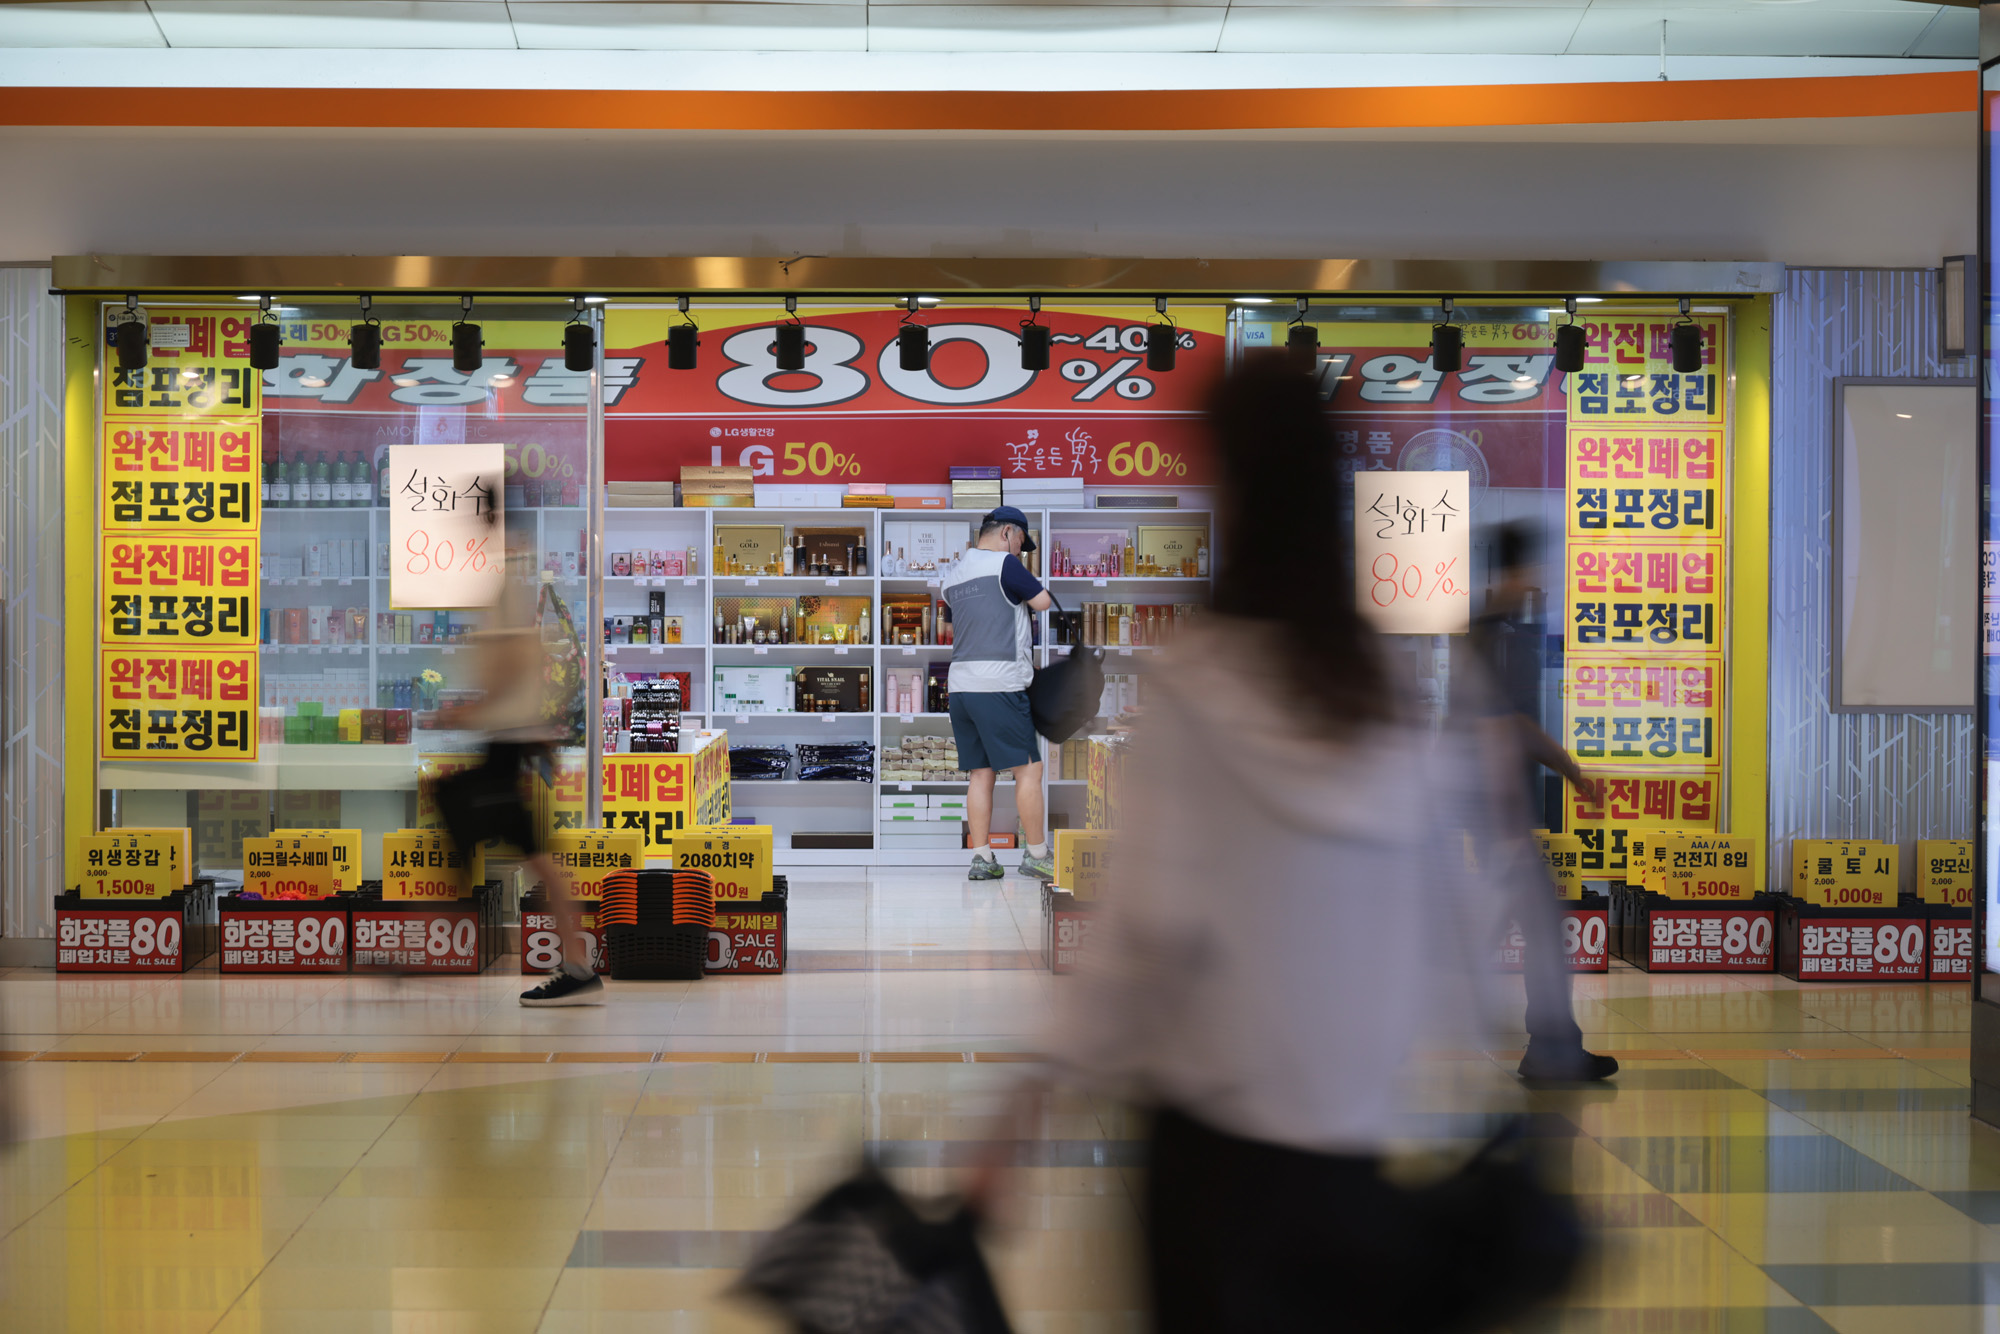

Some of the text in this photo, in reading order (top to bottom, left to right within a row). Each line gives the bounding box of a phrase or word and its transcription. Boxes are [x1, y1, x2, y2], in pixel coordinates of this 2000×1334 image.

[116, 316, 251, 358] 폐업
[310, 323, 352, 341] 50%
[404, 324, 448, 342] 50%
[1246, 331, 1265, 340] VISA
[1512, 323, 1555, 340] 60%
[112, 366, 251, 409] 점포정리
[1577, 373, 1715, 415] 점포정리
[724, 427, 775, 437] LG생활건강
[112, 430, 251, 472] 완전폐업
[782, 441, 861, 477] 50%
[1107, 441, 1187, 477] 60%
[1576, 437, 1715, 480] 완전폐업
[400, 469, 494, 516] 설화수
[111, 481, 250, 523] 점포정리
[1576, 488, 1714, 530] 점포정리
[1365, 490, 1461, 539] 설화수
[111, 544, 249, 586] 완전폐업
[1575, 552, 1714, 593] 완전폐업
[110, 595, 249, 637] 점포정리
[1575, 603, 1713, 644] 점포정리
[110, 658, 249, 700] 완전폐업
[1574, 666, 1713, 707] 완전폐업
[109, 709, 248, 751] 점포정리
[1573, 716, 1713, 758] 점포정리
[1573, 778, 1712, 820] 완전폐업
[1691, 841, 1709, 849] AAA
[1718, 841, 1731, 849] AA
[88, 849, 160, 867] 위생장갑
[248, 852, 328, 867] 아크릴수세미
[551, 852, 632, 867] 닥터클린칫솔
[680, 852, 755, 869] 2080치약
[1673, 852, 1748, 868] 건전지 8입
[1930, 858, 1973, 874] 양모신
[1558, 870, 1575, 878] 99%
[96, 879, 155, 897] 1,500원
[260, 880, 318, 897] 1,000원
[399, 881, 457, 898] 1,500원
[1681, 880, 1740, 898] 1,500원
[1823, 888, 1883, 905] 1,000원
[714, 914, 778, 930] 특가세일
[59, 917, 131, 947] 화장품
[224, 918, 295, 948] 화장품
[355, 918, 427, 948] 화장품
[734, 933, 776, 947] SALE
[1652, 917, 1723, 947] 화장품
[1802, 925, 1874, 956] 화장품
[59, 949, 131, 964] 폐업처분
[135, 957, 176, 966] ALL SALE
[223, 949, 296, 965] 폐업처분
[300, 957, 341, 966] ALL SALE
[432, 958, 473, 967] ALL SALE
[1579, 957, 1602, 965] SALE
[1651, 949, 1723, 964] 폐업처분
[1727, 957, 1768, 965] ALL SALE
[1801, 957, 1874, 973] 폐업처분
[1878, 965, 1919, 974] ALL SALE
